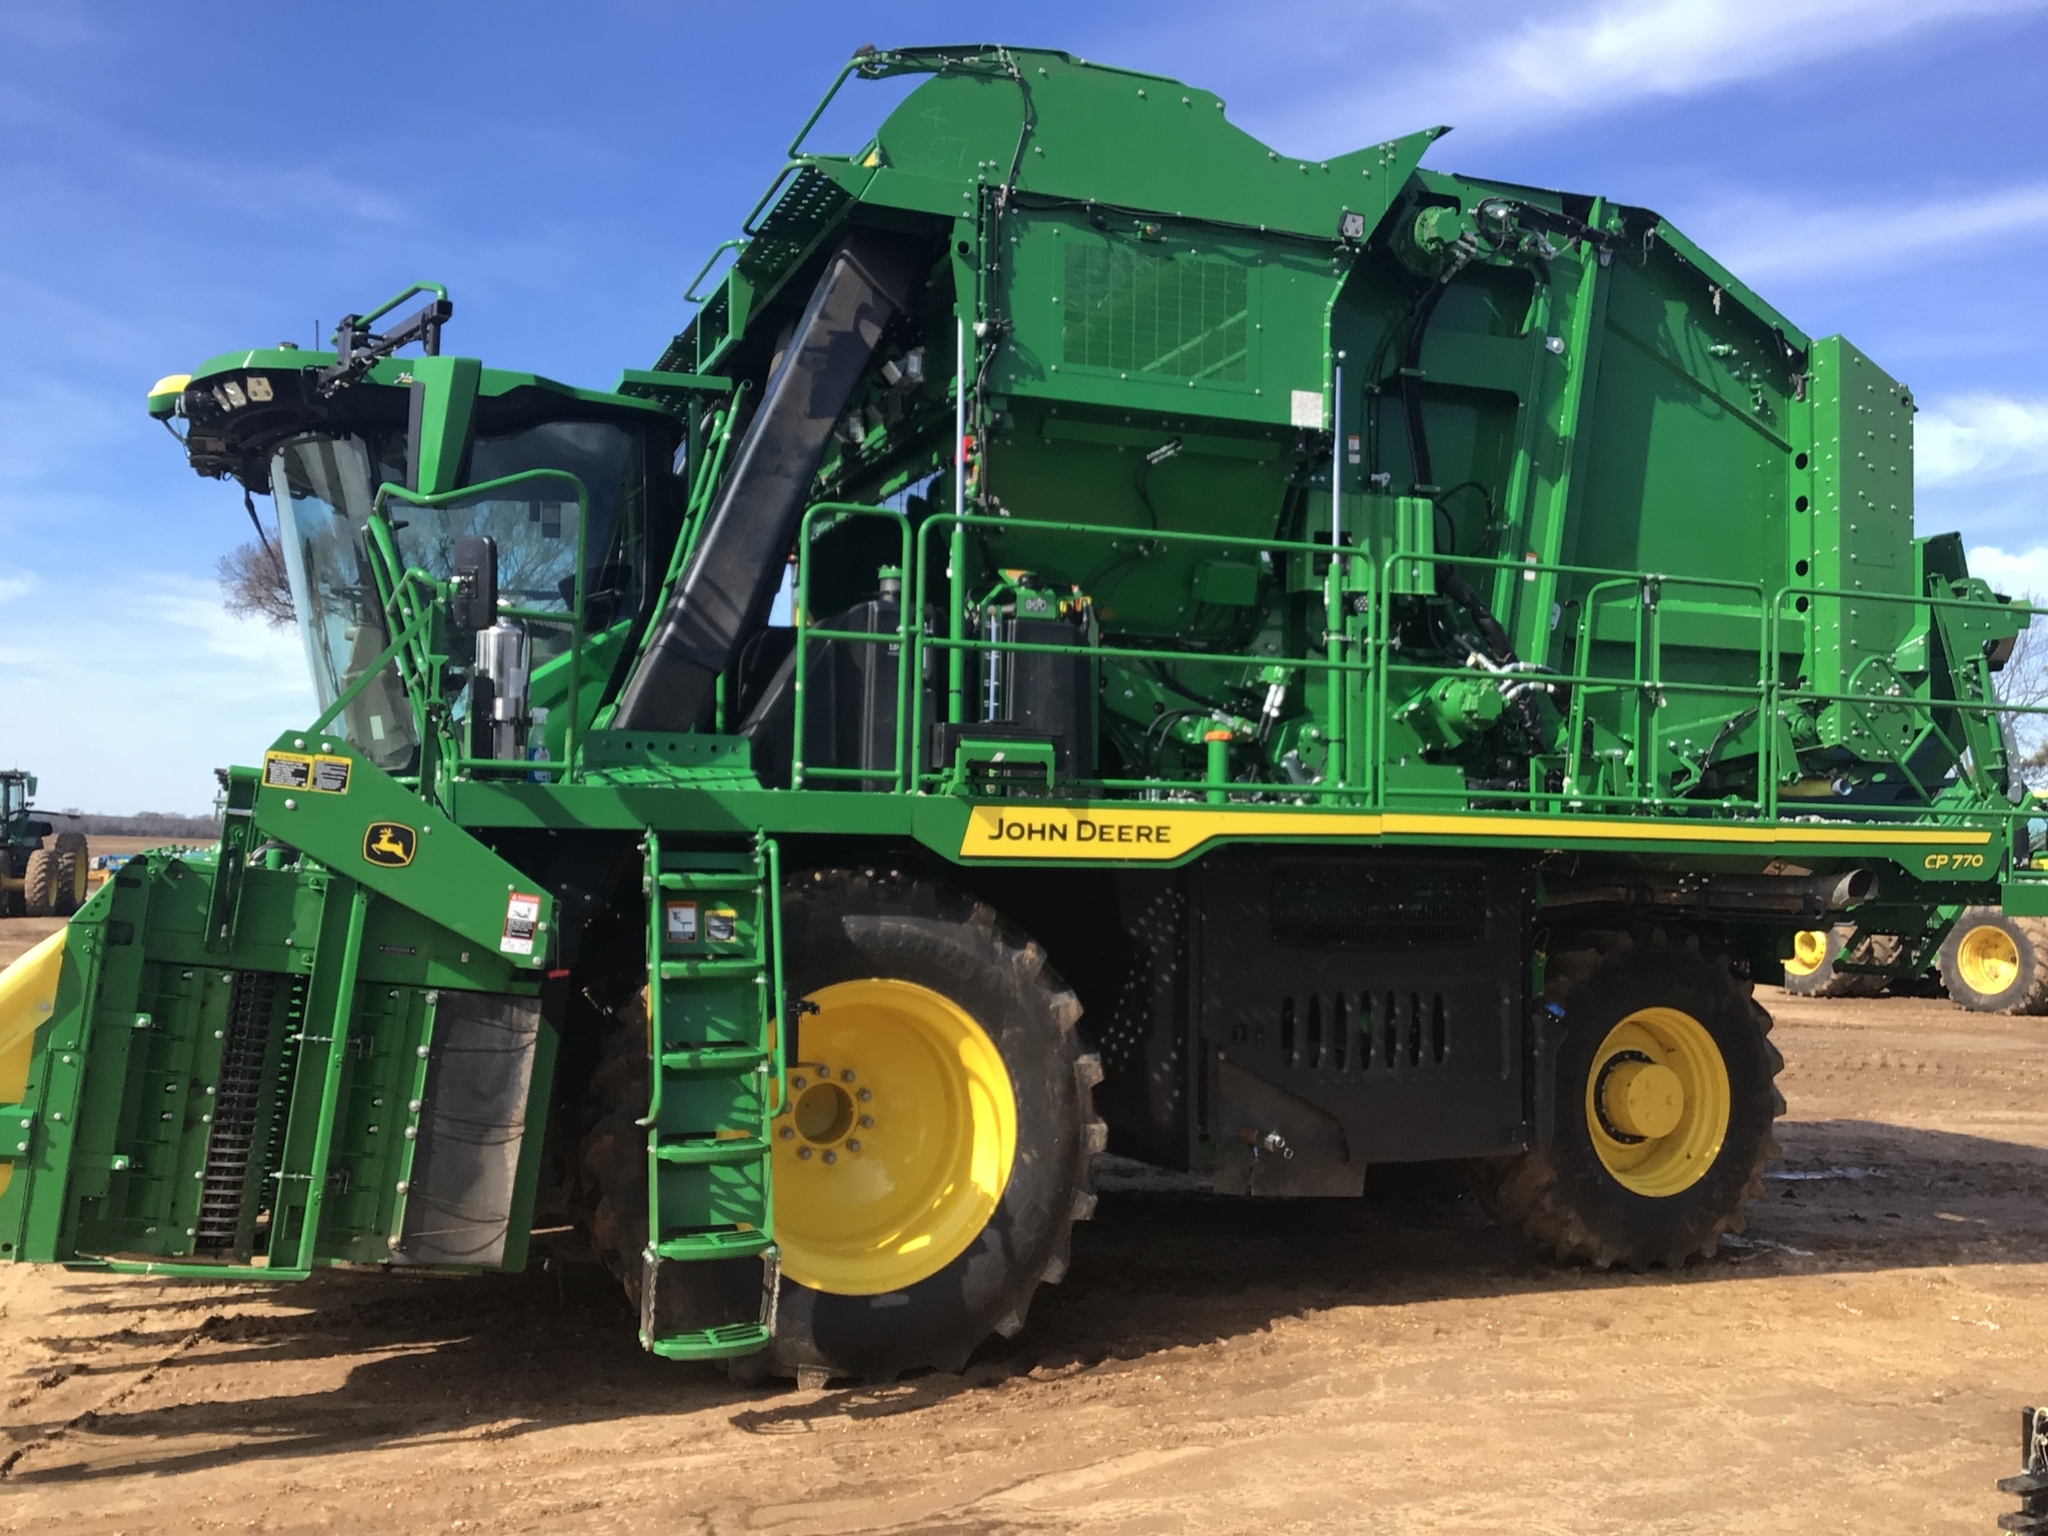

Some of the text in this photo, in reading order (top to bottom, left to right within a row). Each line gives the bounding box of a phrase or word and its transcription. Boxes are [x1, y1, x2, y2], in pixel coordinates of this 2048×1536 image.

[988, 818, 1171, 843] JOHN DEERE
[1924, 854, 1984, 870] CP 770
